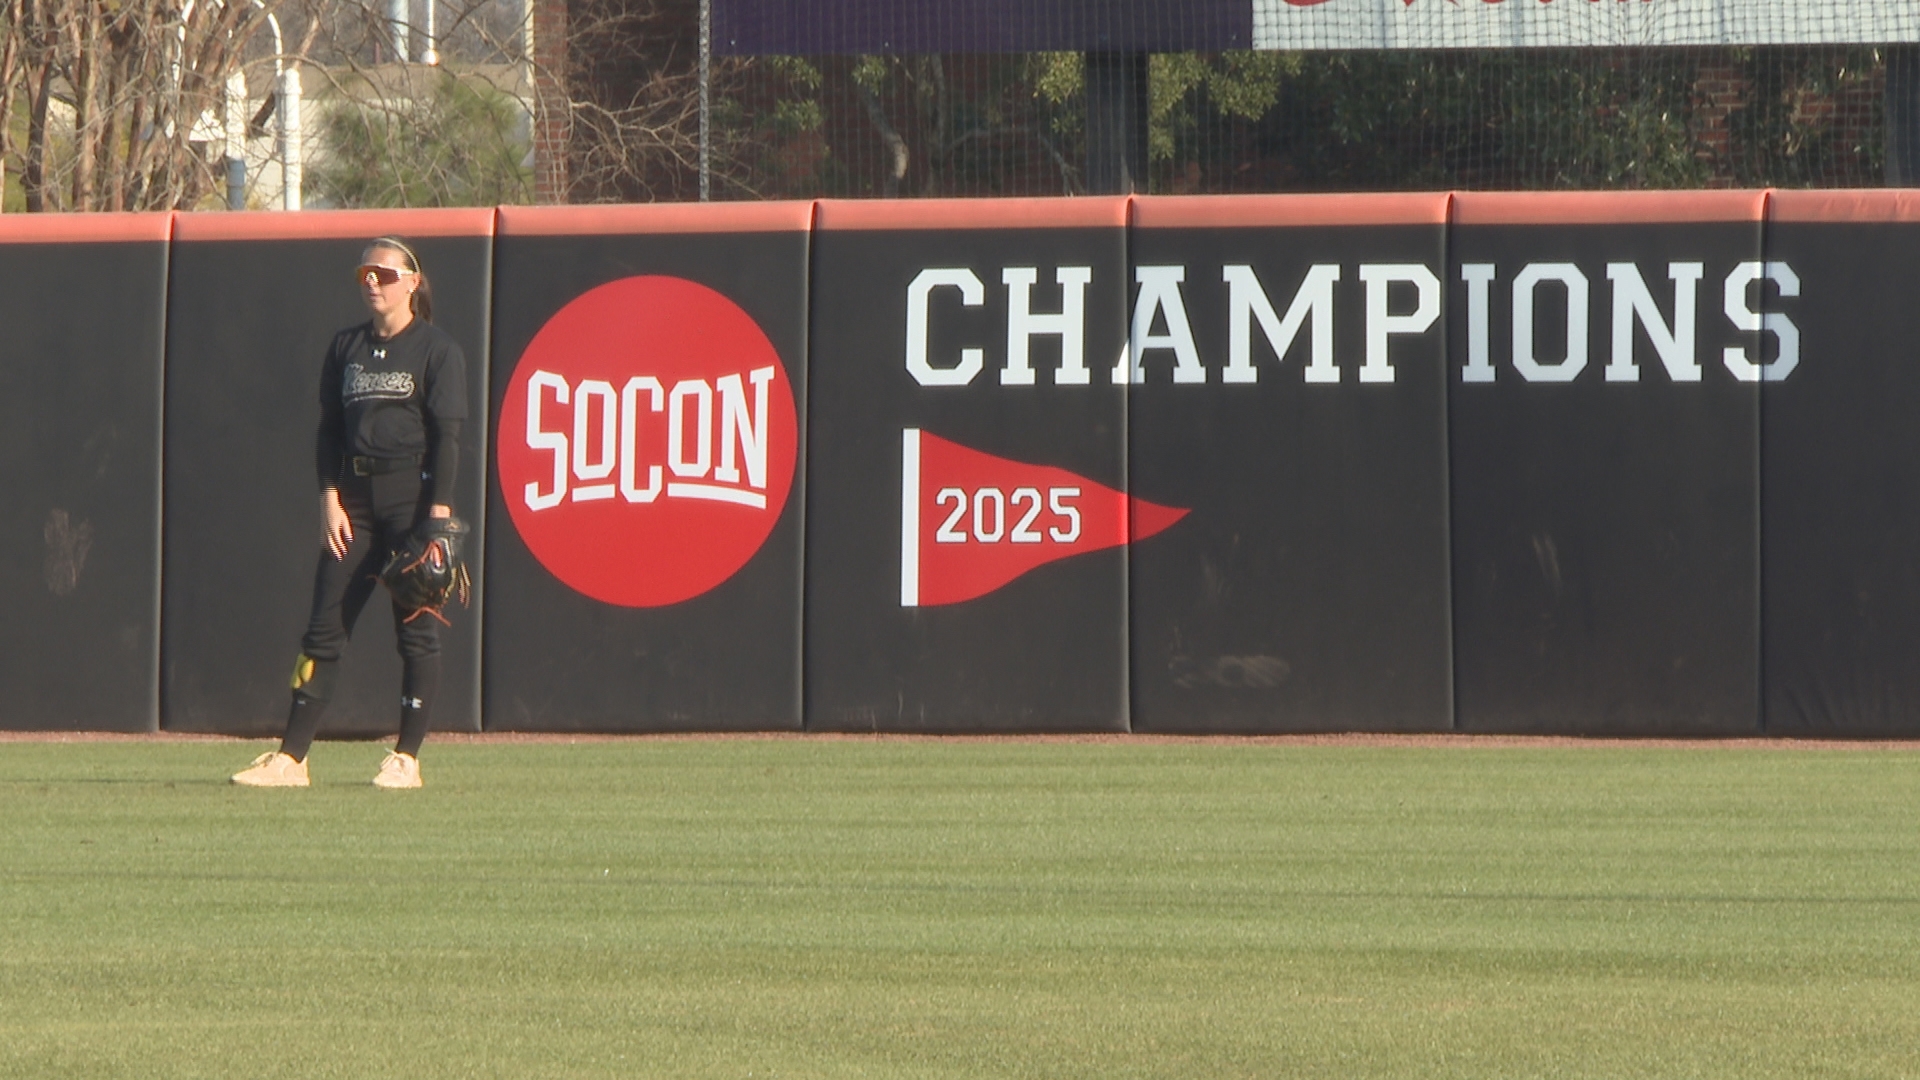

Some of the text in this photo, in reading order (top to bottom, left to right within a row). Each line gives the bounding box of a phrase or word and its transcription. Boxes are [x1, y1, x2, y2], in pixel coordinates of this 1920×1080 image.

[905, 261, 1801, 386] CHAMPIONS
[524, 365, 775, 512] SOCON
[935, 486, 1082, 544] 2025
